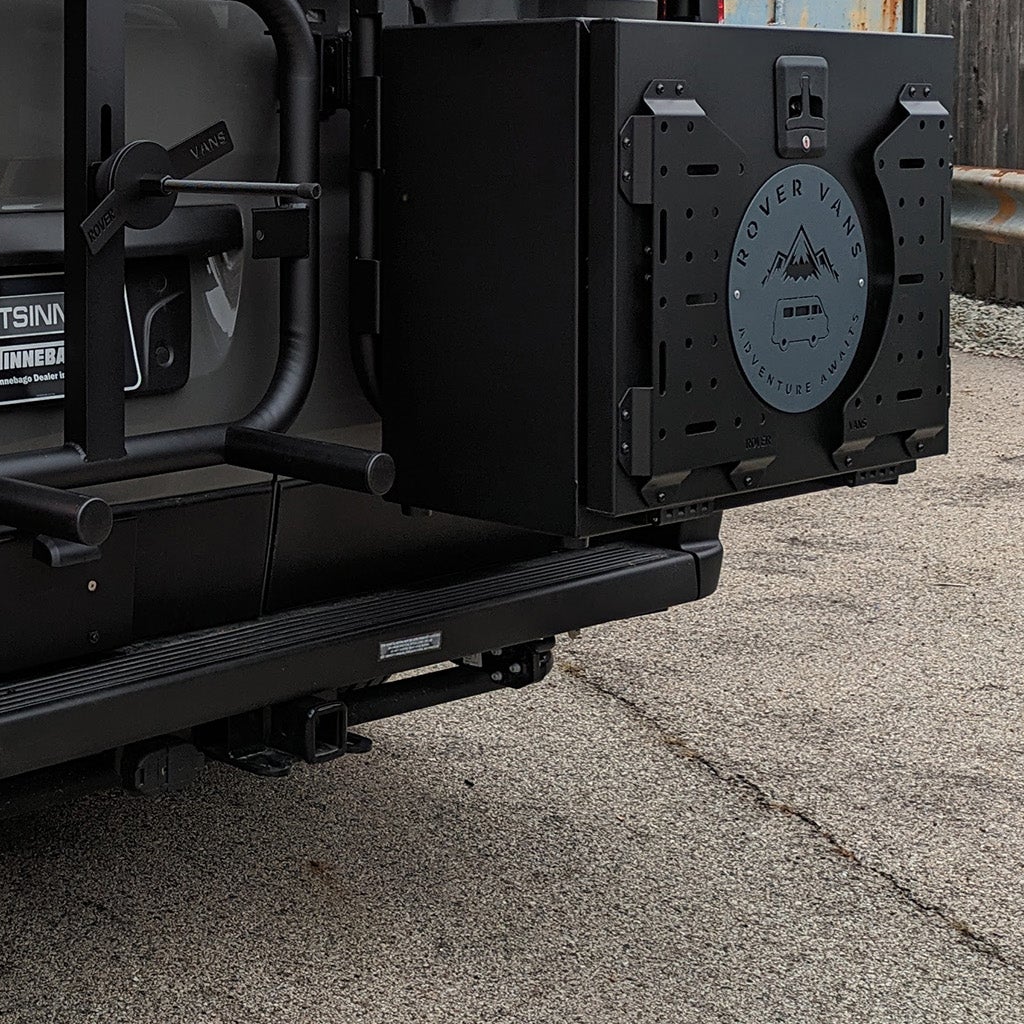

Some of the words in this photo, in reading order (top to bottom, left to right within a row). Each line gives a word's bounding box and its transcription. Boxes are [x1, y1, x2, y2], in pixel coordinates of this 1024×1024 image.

[189, 130, 226, 160] VANS
[88, 208, 116, 243] ROVER
[736, 179, 802, 267] ROVER
[819, 182, 862, 258] VANS
[738, 327, 812, 395] ADVENTURE
[820, 313, 860, 385] AWAITS
[33, 372, 58, 382] Dealer
